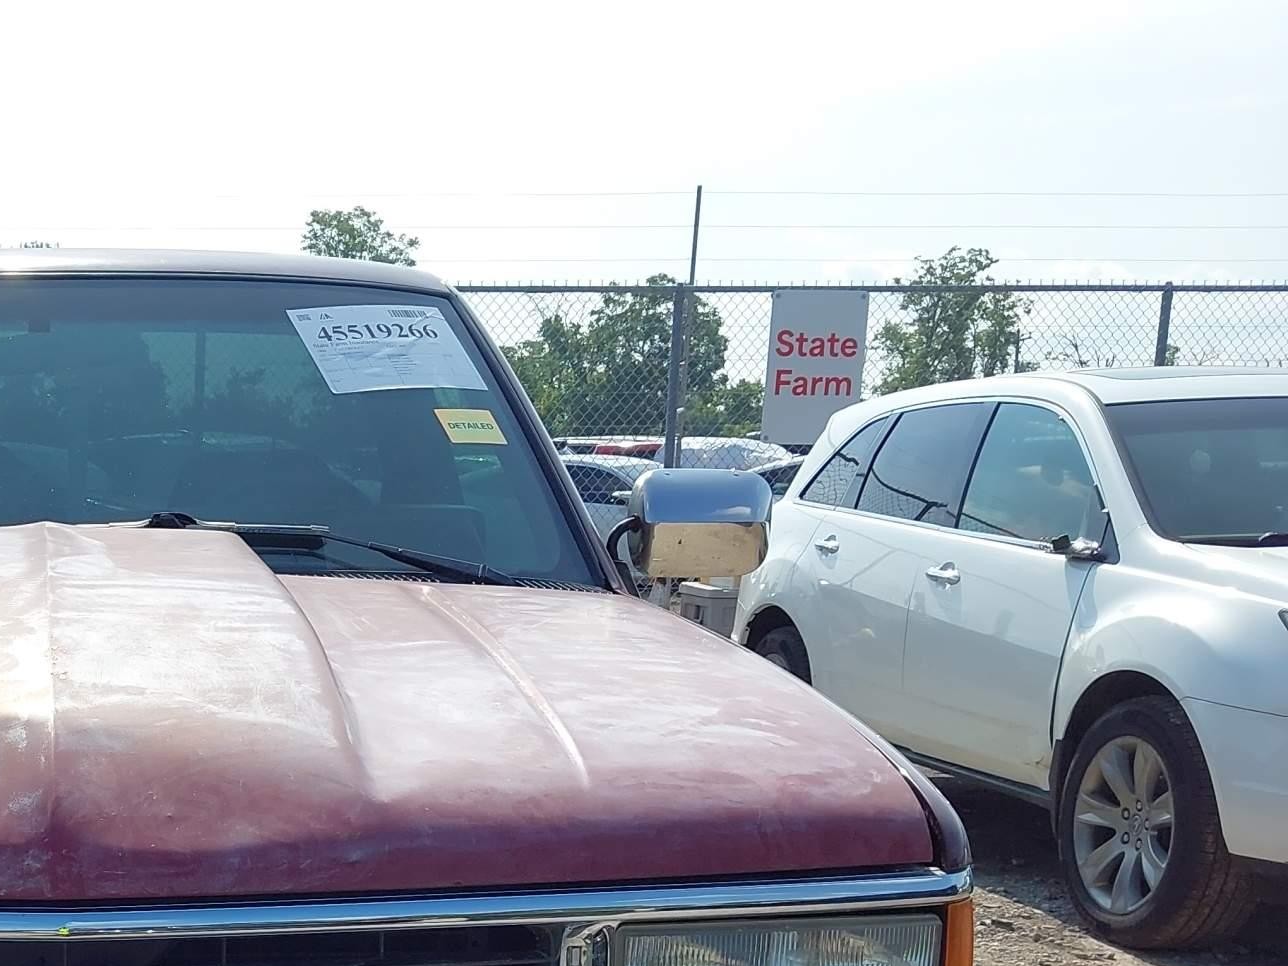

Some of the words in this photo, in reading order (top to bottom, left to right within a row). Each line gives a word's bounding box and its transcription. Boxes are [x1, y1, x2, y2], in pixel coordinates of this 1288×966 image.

[317, 323, 439, 342] 45519266
[775, 329, 858, 358] State
[774, 369, 852, 396] Farm
[447, 422, 494, 430] DETAILED
